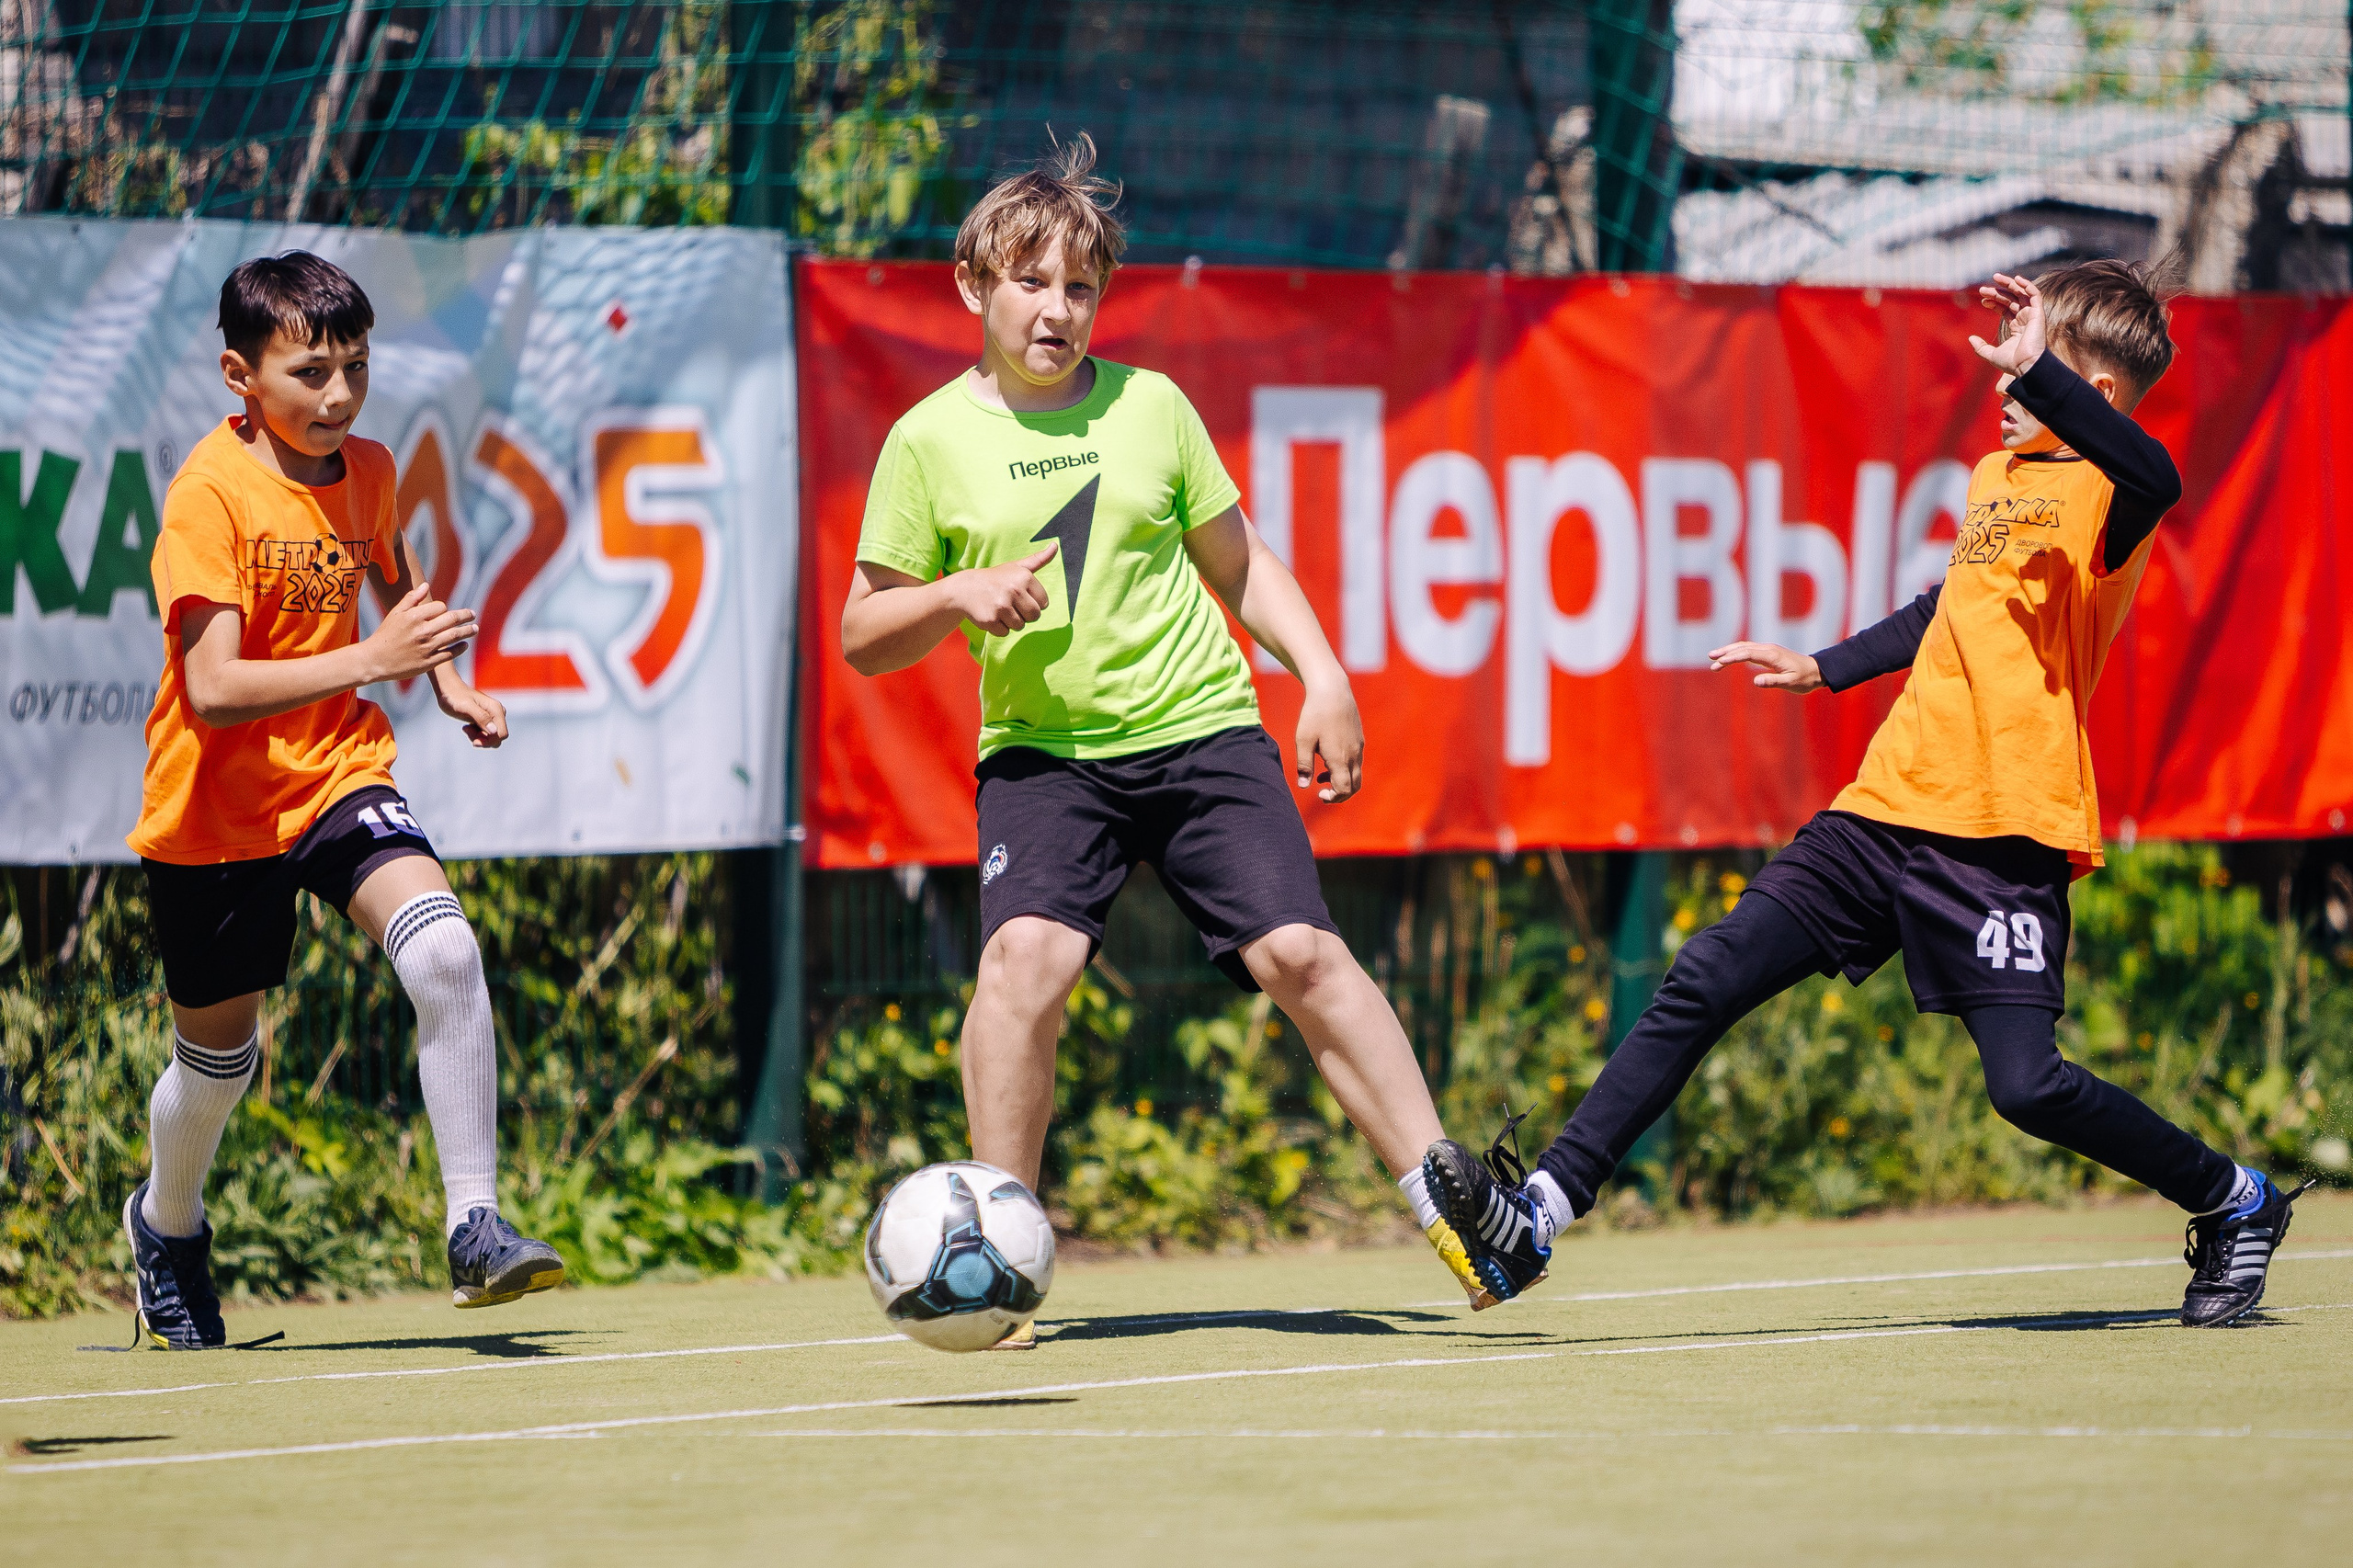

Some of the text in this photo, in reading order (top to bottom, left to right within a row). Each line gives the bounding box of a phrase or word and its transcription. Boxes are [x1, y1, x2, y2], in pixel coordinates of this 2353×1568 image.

[1008, 451, 1099, 480] Первые
[279, 573, 357, 613] 2025
[1252, 386, 1973, 767] Первые
[1976, 910, 2046, 972] 49
